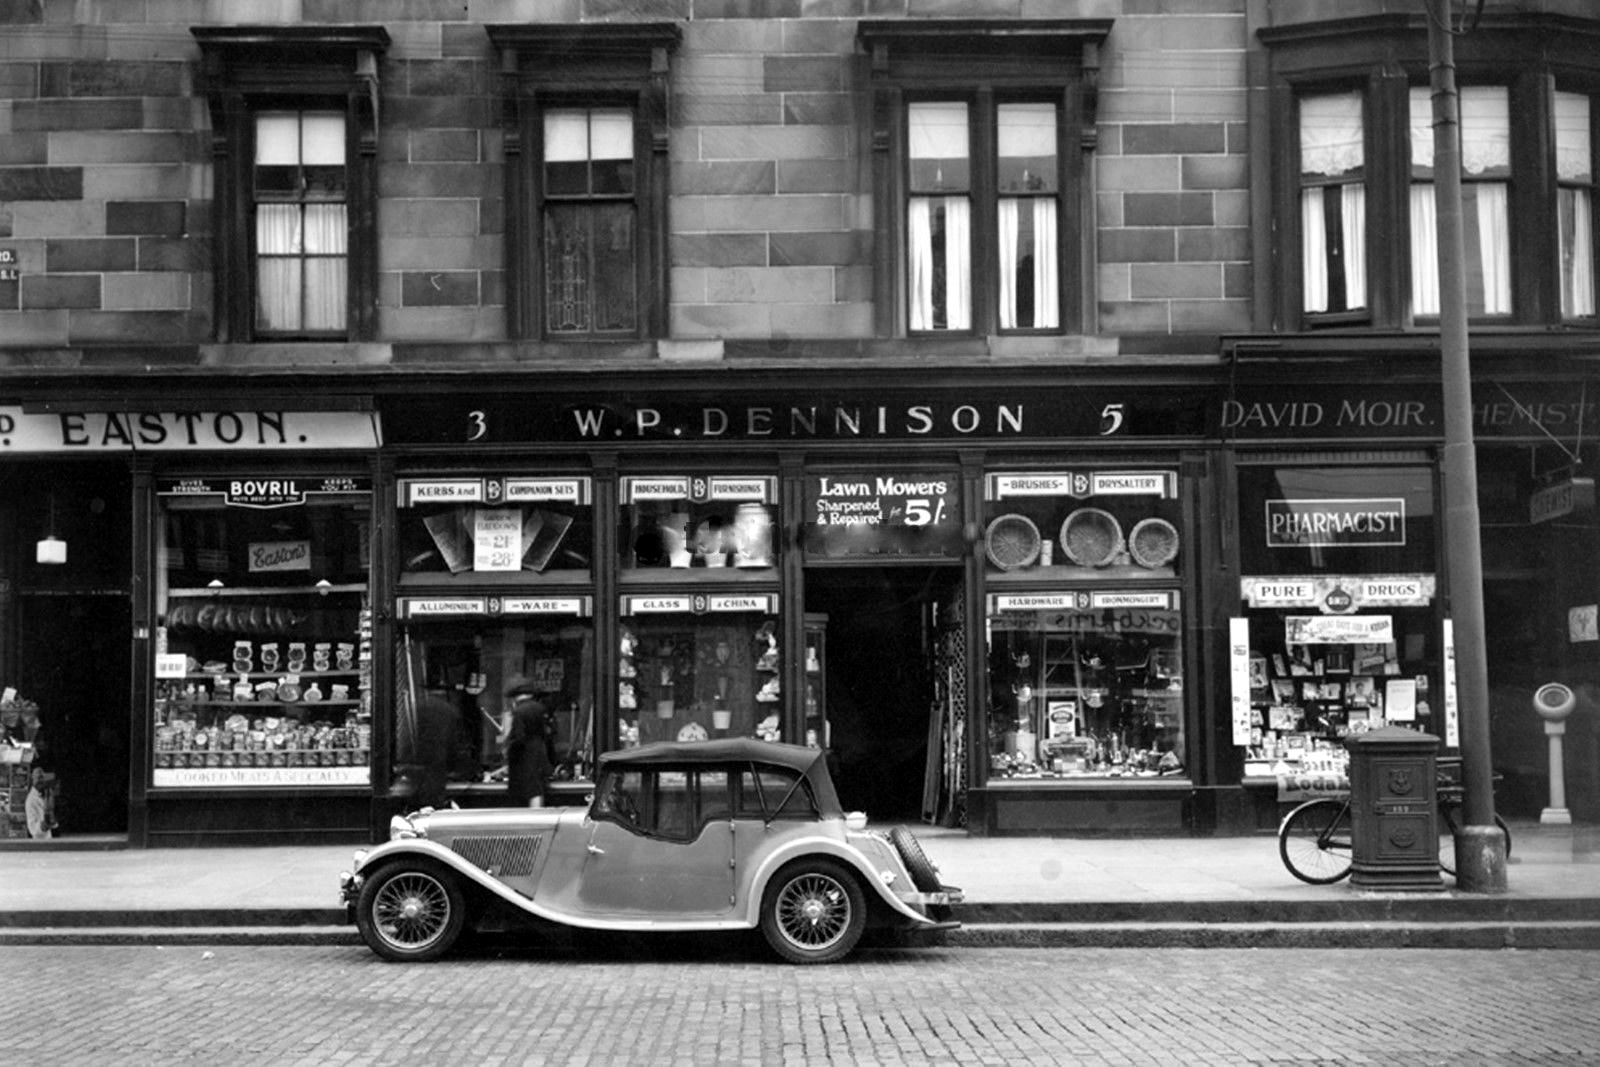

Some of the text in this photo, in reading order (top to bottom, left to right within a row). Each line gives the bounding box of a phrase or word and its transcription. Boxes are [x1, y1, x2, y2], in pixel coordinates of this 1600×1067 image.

[1220, 400, 1597, 428] DAVID MOIR. HEMIST.
[468, 411, 487, 441] 3
[703, 405, 1023, 436] DENNISON
[1101, 403, 1124, 436] 5
[60, 412, 307, 445] EASTON.
[230, 481, 300, 496] BOVRIL
[554, 484, 574, 495] SETS
[714, 484, 762, 494] FURNISHINGS
[819, 476, 948, 497] Lawn Mowers
[1098, 479, 1157, 489] DRYSALTERY
[417, 486, 455, 496] KERBS
[816, 498, 881, 515] Sharpened
[816, 511, 883, 527] & Repaired
[1272, 511, 1400, 534] PHARMACIST
[1261, 584, 1416, 597] PURE DRUGS
[643, 600, 680, 609] GLASS
[723, 599, 757, 608] CHINA
[1008, 597, 1064, 606] HARDWARE
[1101, 595, 1160, 605] IRONMONGERY
[175, 771, 227, 783] COOKED
